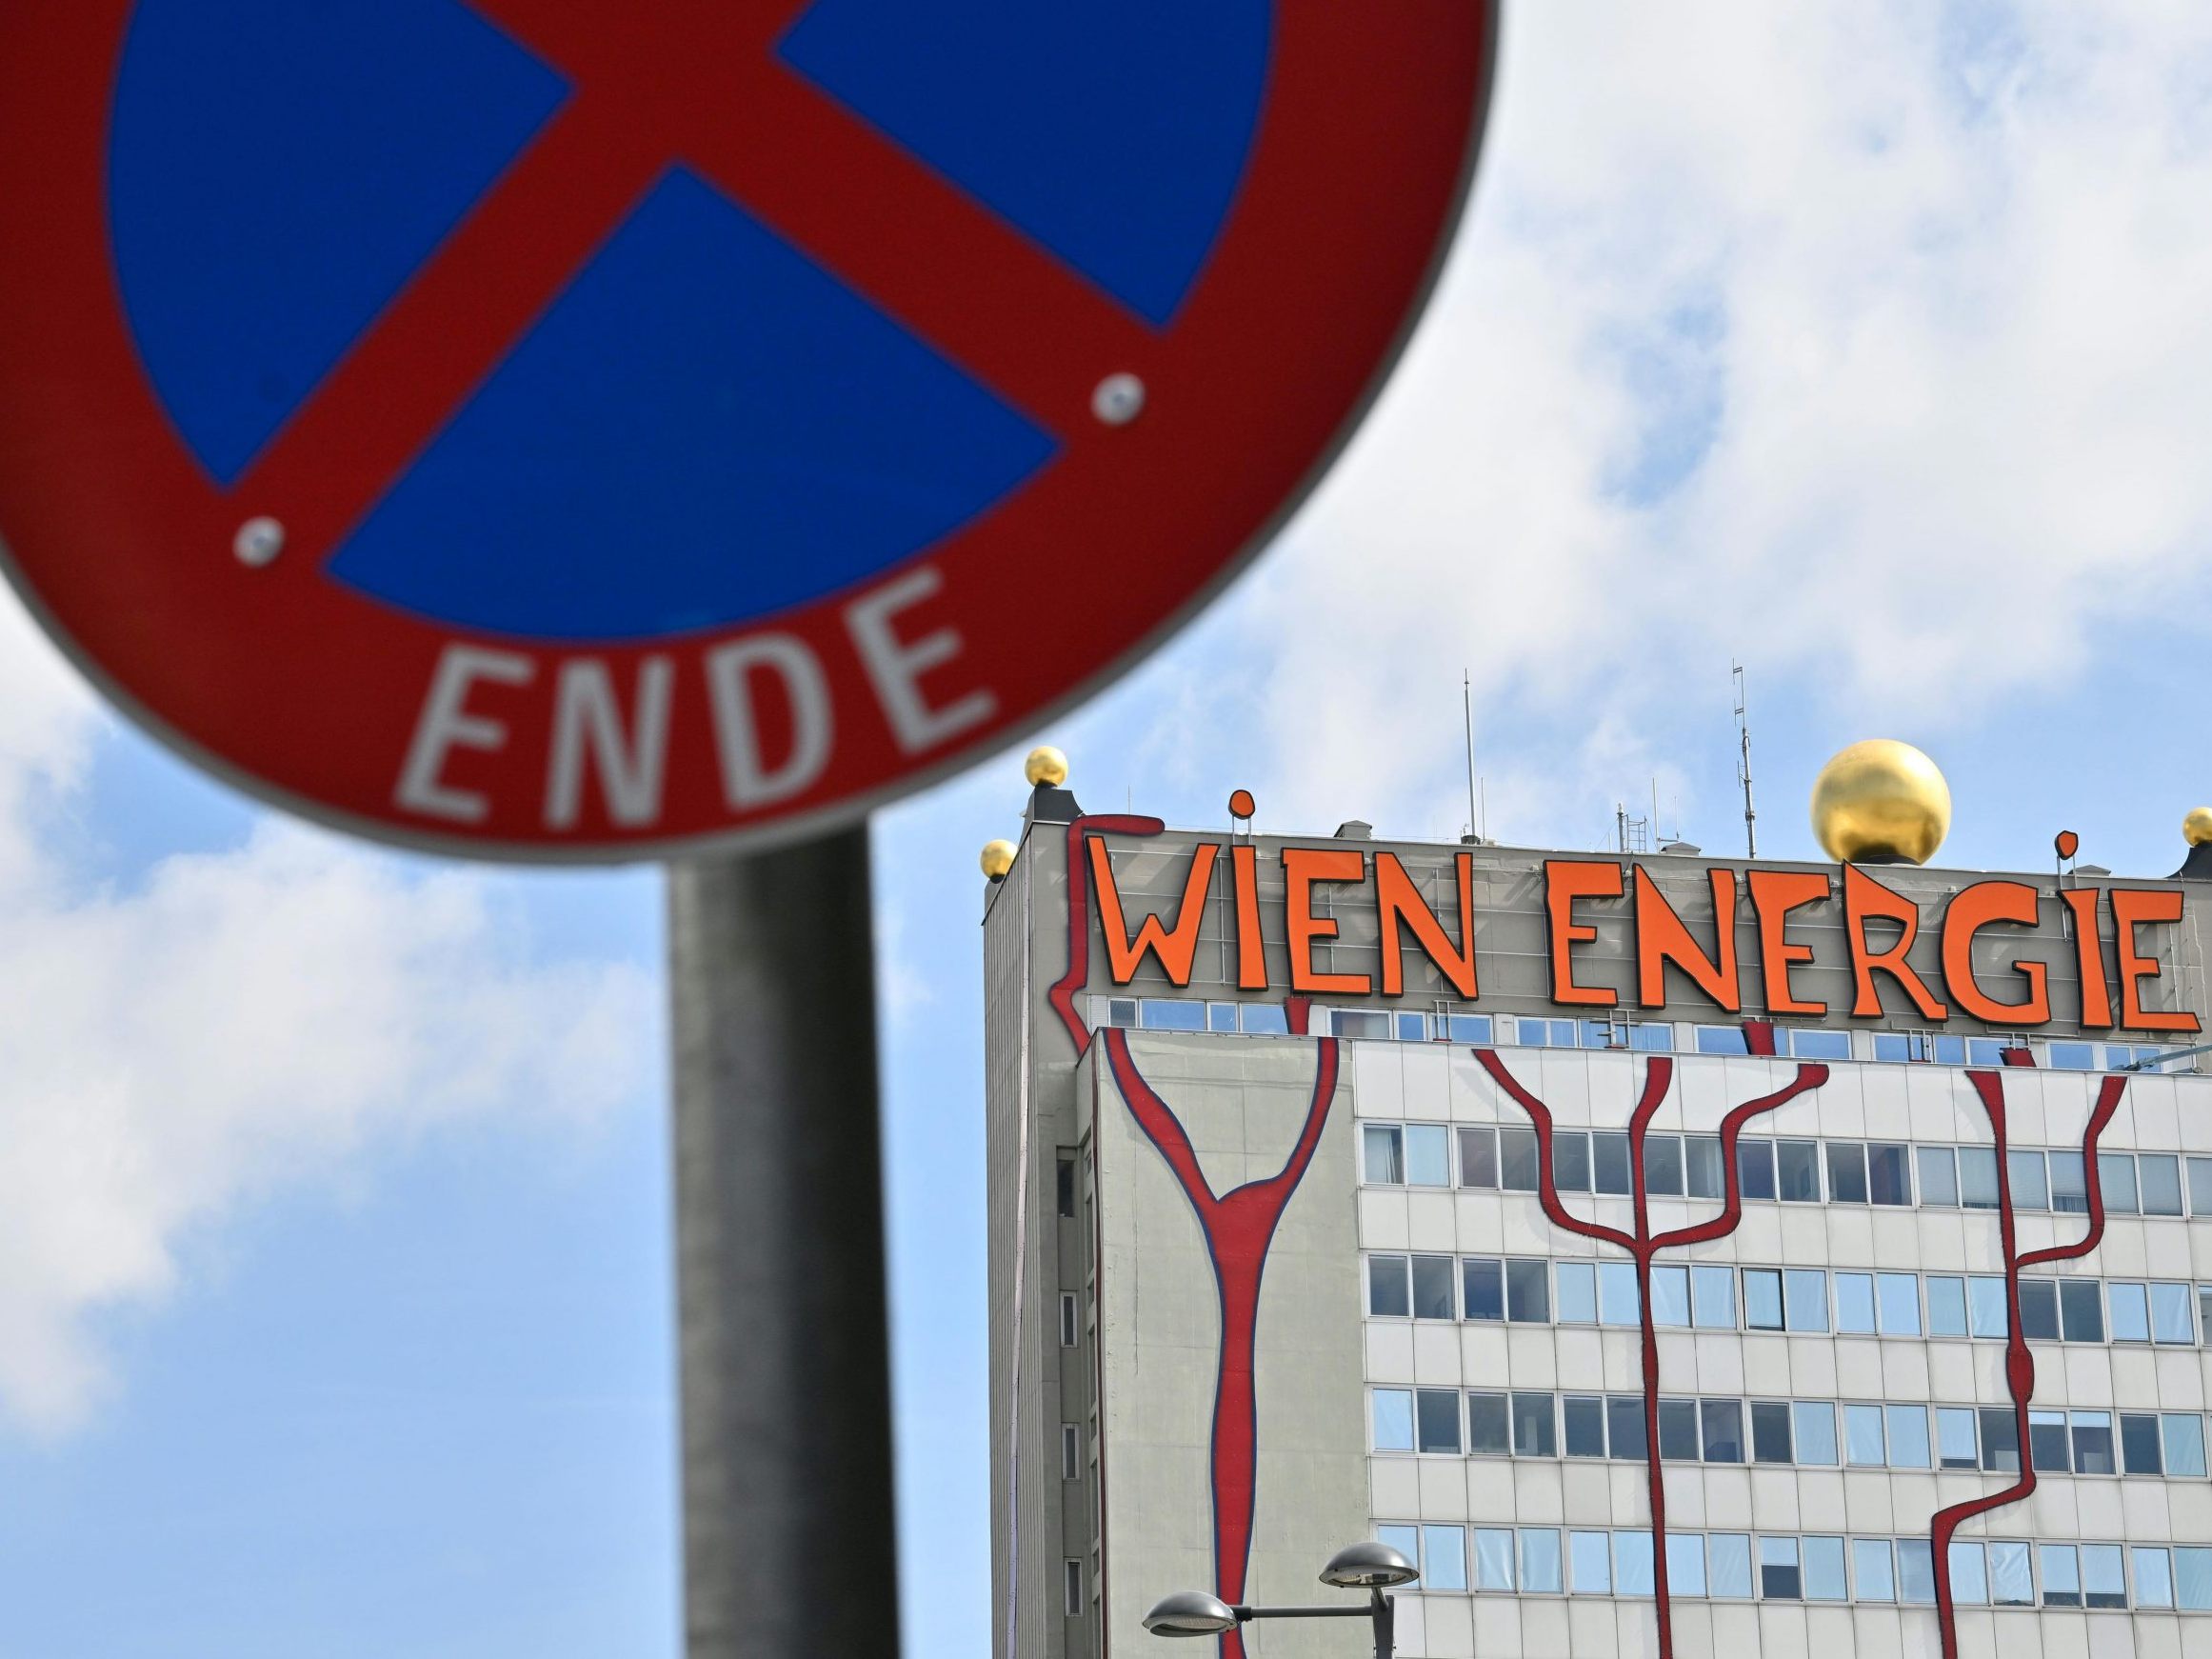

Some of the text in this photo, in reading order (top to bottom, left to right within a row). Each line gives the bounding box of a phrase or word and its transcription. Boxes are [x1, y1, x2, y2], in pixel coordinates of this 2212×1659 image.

[394, 566, 998, 830] ENDE
[1086, 790, 2202, 1033] WIEN ENERGIE
